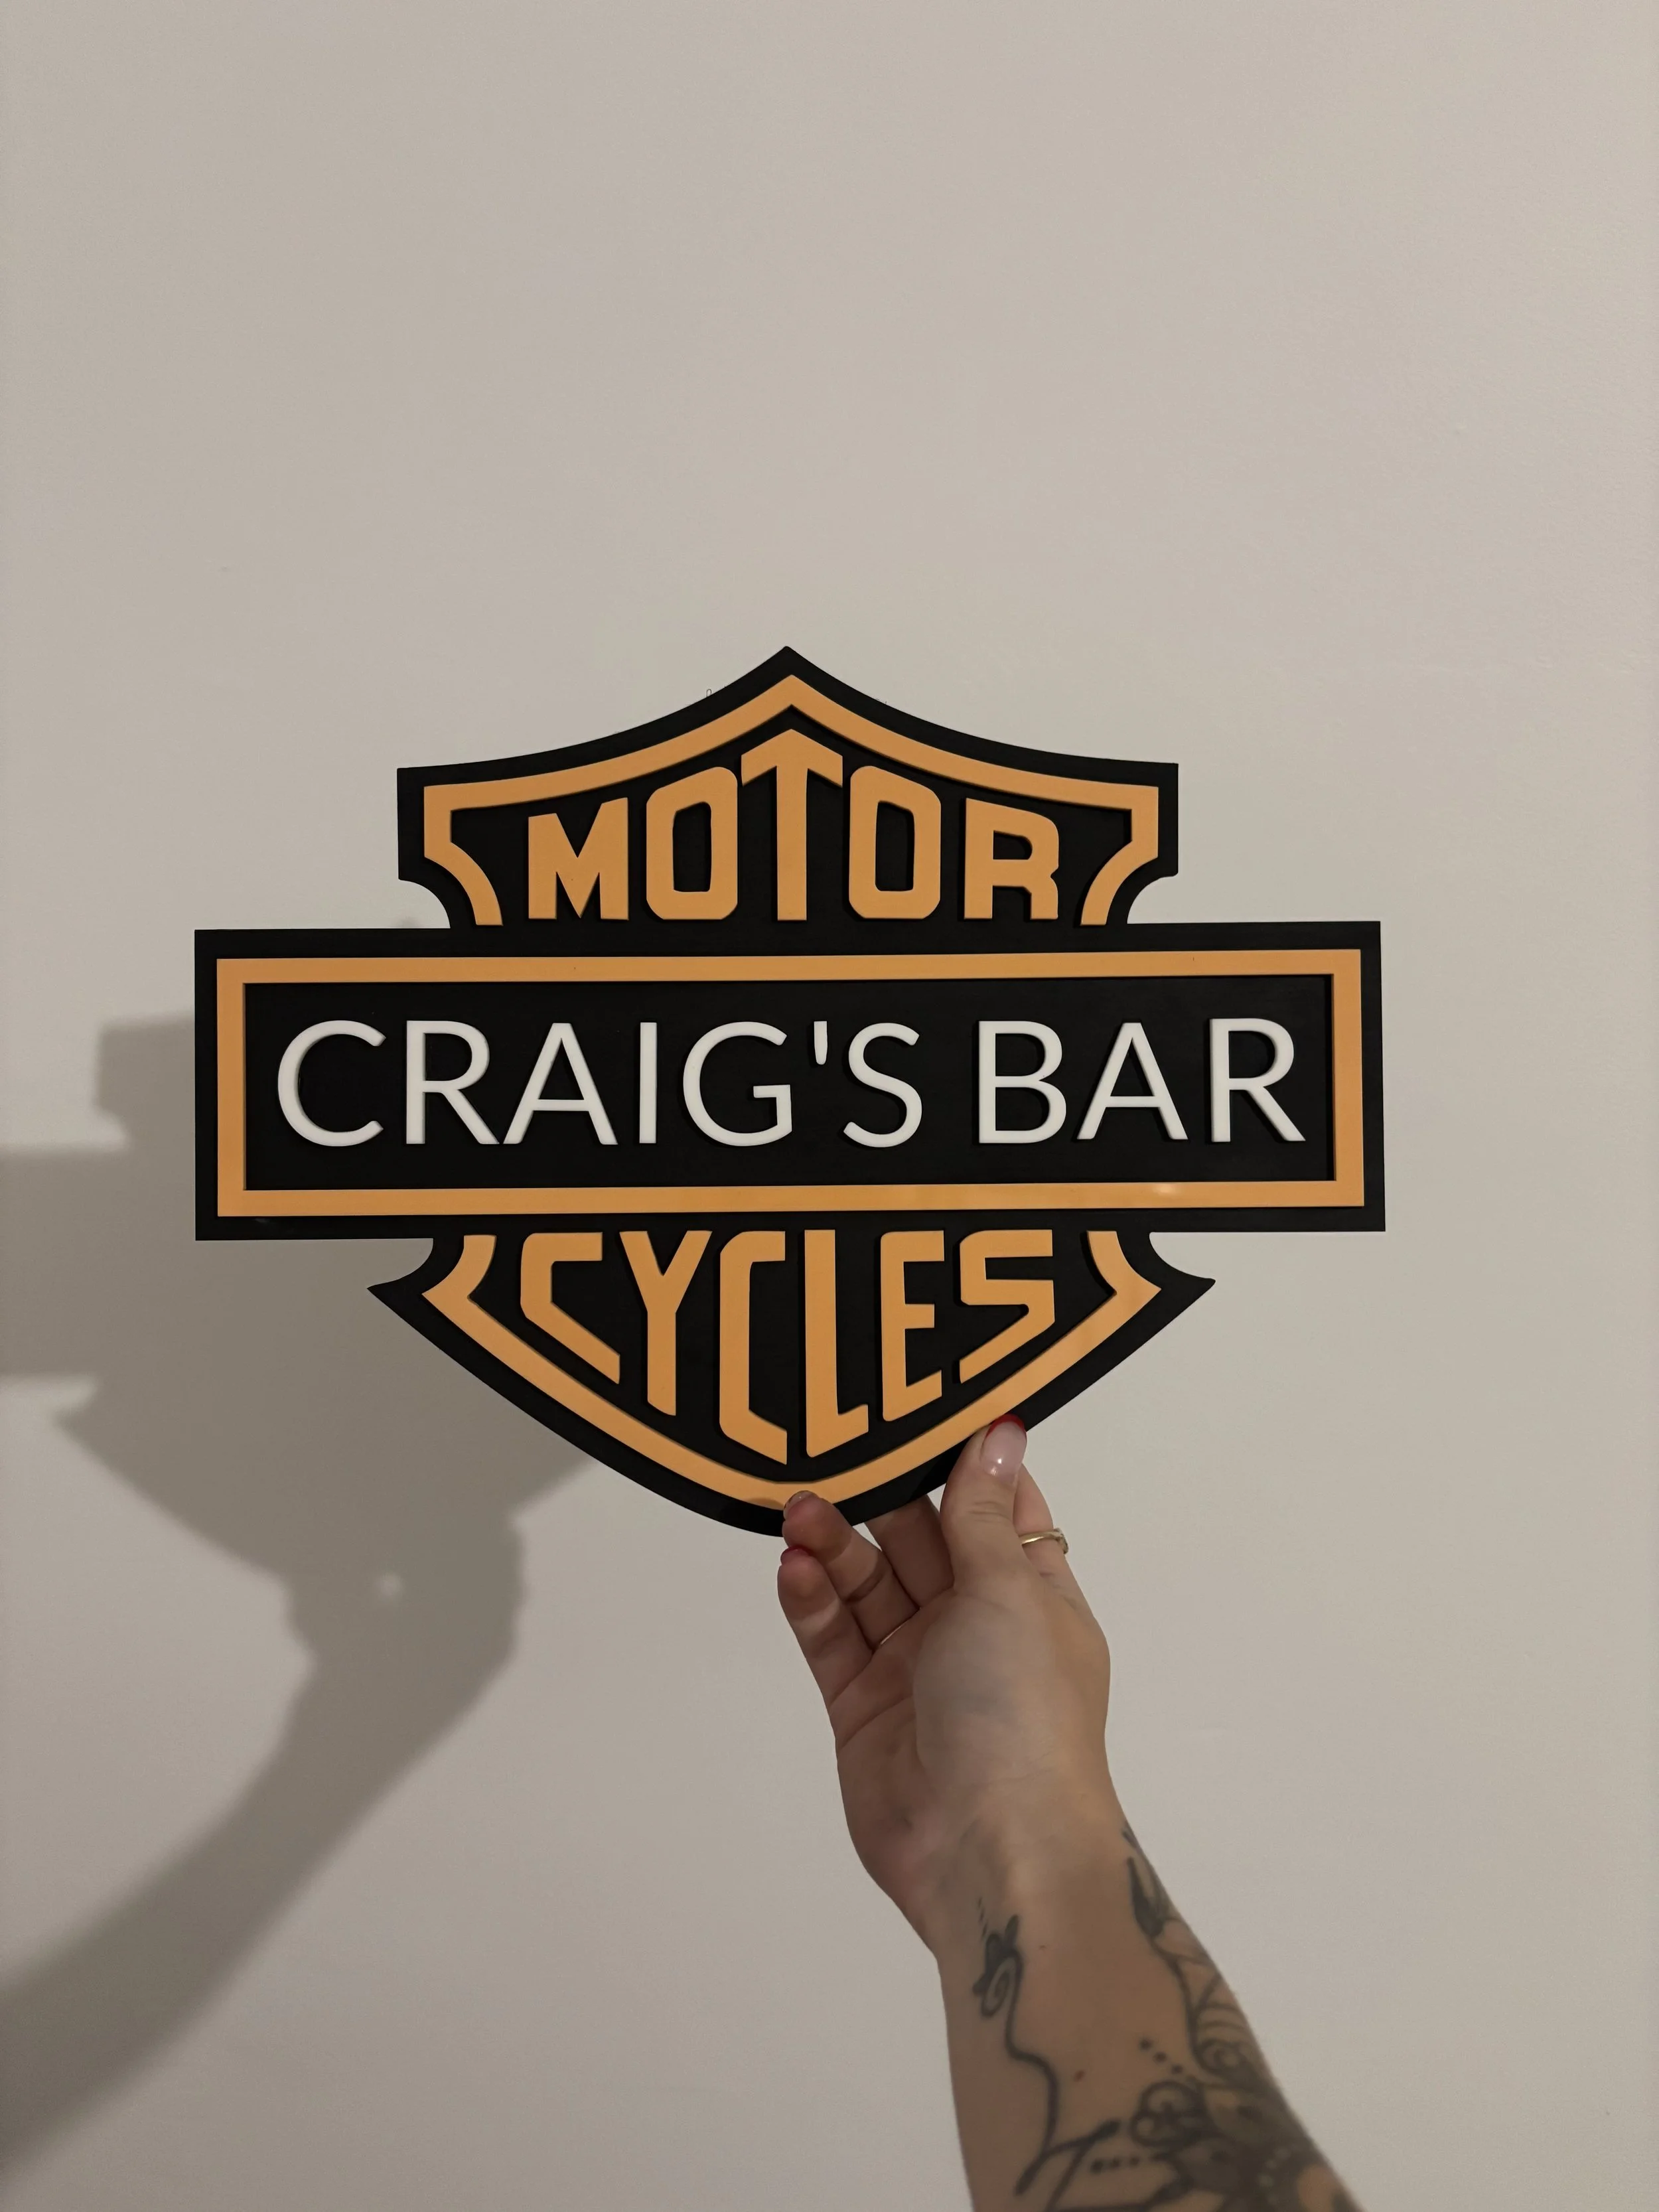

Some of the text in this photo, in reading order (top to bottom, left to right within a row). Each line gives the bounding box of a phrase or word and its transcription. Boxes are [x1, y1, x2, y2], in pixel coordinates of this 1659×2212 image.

[528, 729, 1060, 921] MOTOR
[277, 1017, 1306, 1147] CRAIG'S BAR
[520, 1229, 1055, 1465] CYCLES
